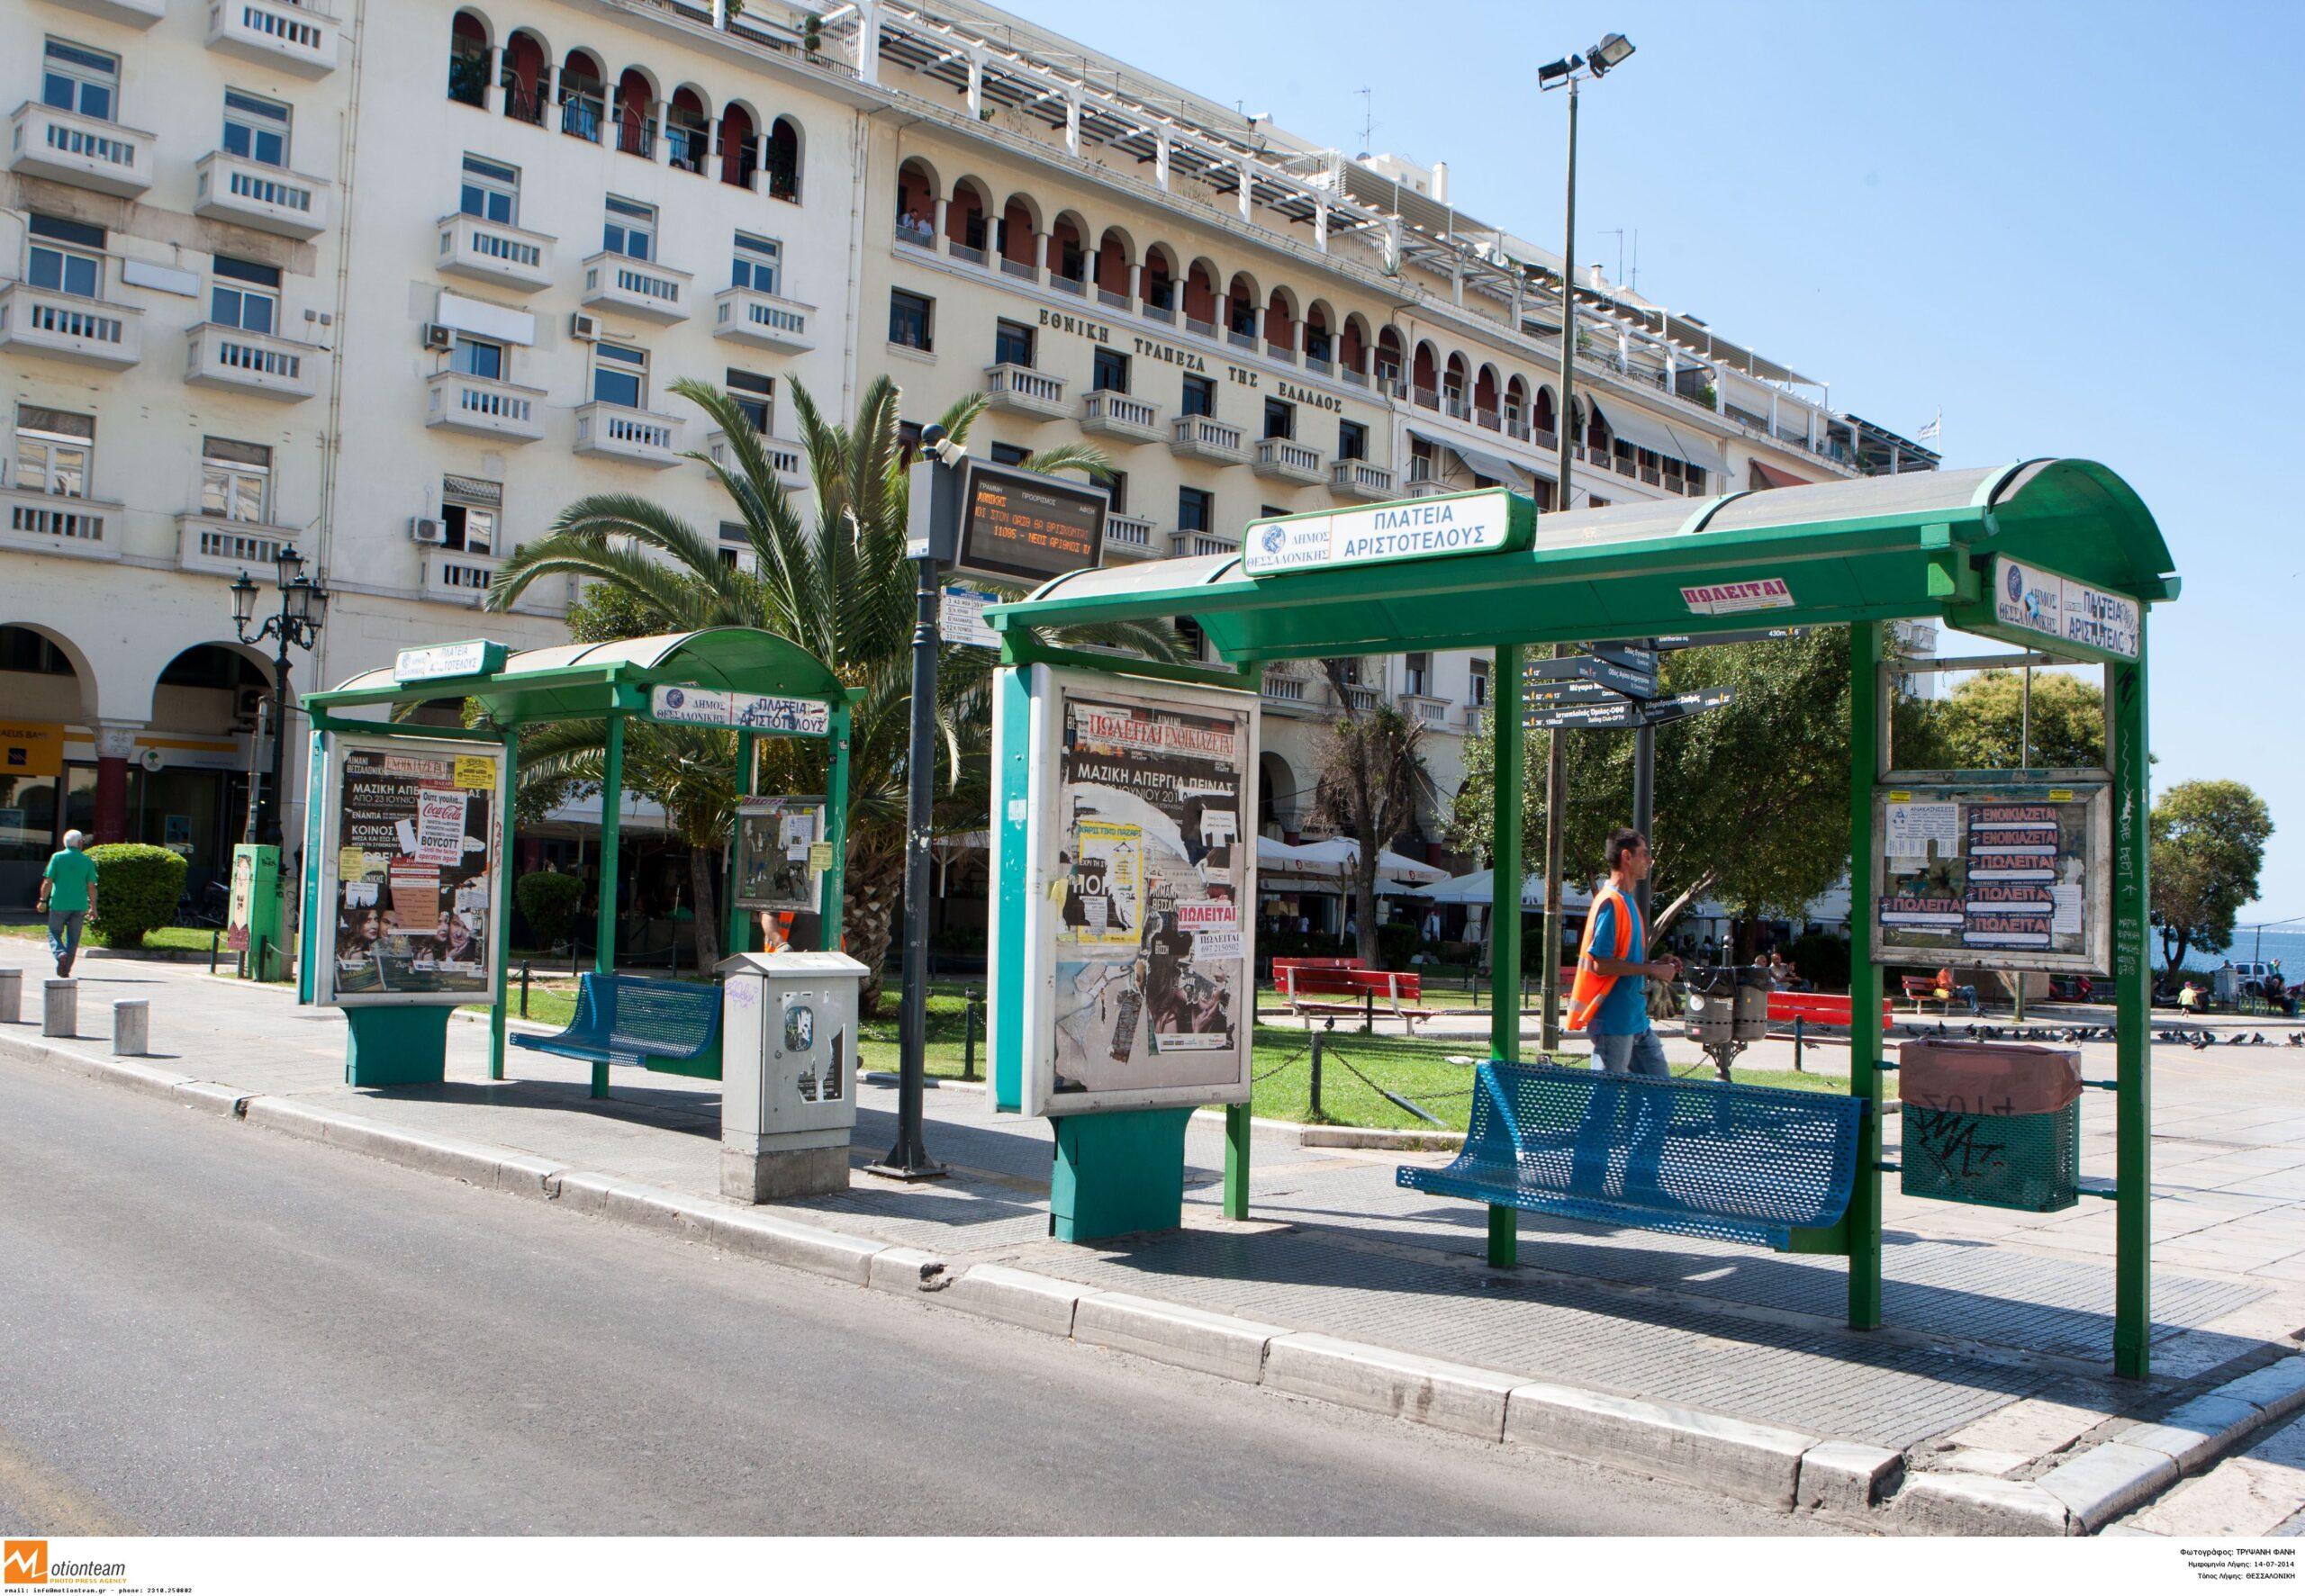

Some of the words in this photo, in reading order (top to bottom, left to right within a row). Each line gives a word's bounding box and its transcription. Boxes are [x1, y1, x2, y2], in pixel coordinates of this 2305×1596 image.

[1038, 308, 1109, 344] ΕΘΝΙΚΗ
[1134, 337, 1206, 373] ΤΡΑΠΕΖΑ
[1228, 365, 1259, 388] ΤΗΣ
[1279, 381, 1342, 414] ΕΛΛΑΔΟΣ
[979, 482, 1003, 494] ΓΡΑΜΜΗ
[1021, 491, 1056, 506] ΠΡΟΟΡΙΣΜΟΣ
[1374, 504, 1453, 530] ΠΛΑΤΕΙΑ
[1291, 530, 1330, 545] ΔΗΜΟΣ
[1344, 525, 1486, 557] ΑΡΙΣΤΟΤΕΛΟΥΣ
[1246, 549, 1329, 568] ΘΕΣΣΑΛΟΝΙΚΗΣ
[1682, 580, 1788, 604] ΠΩΛΕΙΤΑΙ
[2084, 591, 2122, 622] ΠΛΑΤΕΙΑ
[2068, 617, 2136, 655] ΑΡΙΣΤΟΤΕΛΟΣ
[692, 699, 726, 711] ΔΗΜΟΣ
[759, 698, 807, 715] ΠΛΑΤΕΙΑ
[656, 709, 726, 724] ΘΕΣΣΑΛΟΝΙΚΗΣ
[739, 713, 824, 733] ΑΡΙΣΤΟΤΕΛΟΥΣ
[1088, 714, 1163, 744] ΠΩΛΕΙΤΑΙ
[1165, 727, 1234, 754] ΕΝΟΙΚΙΑΖΕΤΑΙ
[1078, 763, 1129, 784] ΜΑΖΙΚΗ
[1133, 771, 1185, 789] ΑΠΕΡΓΙΑ
[1189, 778, 1233, 792] ΠΕΙΝΑΣ
[353, 783, 394, 794] ΜΑΖΙΚΗ
[352, 794, 373, 803] ΑΠΟ
[375, 795, 384, 803] 23
[1162, 790, 1180, 803] 201
[352, 811, 382, 820] ΕΝΑΝΤΙΑ
[1982, 807, 2056, 822] ΕΝΟΙΚΙΑΖΕΤΑΙ
[351, 825, 394, 836] ΚΟΙΝΟΣ
[1982, 831, 2058, 844] ΕΝΟΙΚΙΑΖΕΤΑΙ
[421, 836, 459, 849] BOYCOTT
[419, 852, 442, 861] operates
[1981, 855, 2056, 869] ΠΩΛΕΙΤΑΙ
[1978, 888, 2053, 901] ΠΩΛΕΙΤΑΙ
[1893, 898, 1965, 912] ΠΩΛΕΙΤΑΙ
[1178, 906, 1236, 922] ΠΩΛΕΙΤΑΙ
[1975, 918, 2051, 933] ΠΩΛΕΙΤΑΙ
[1200, 933, 1240, 944] ΠΩΛΕΙΤΑΙ
